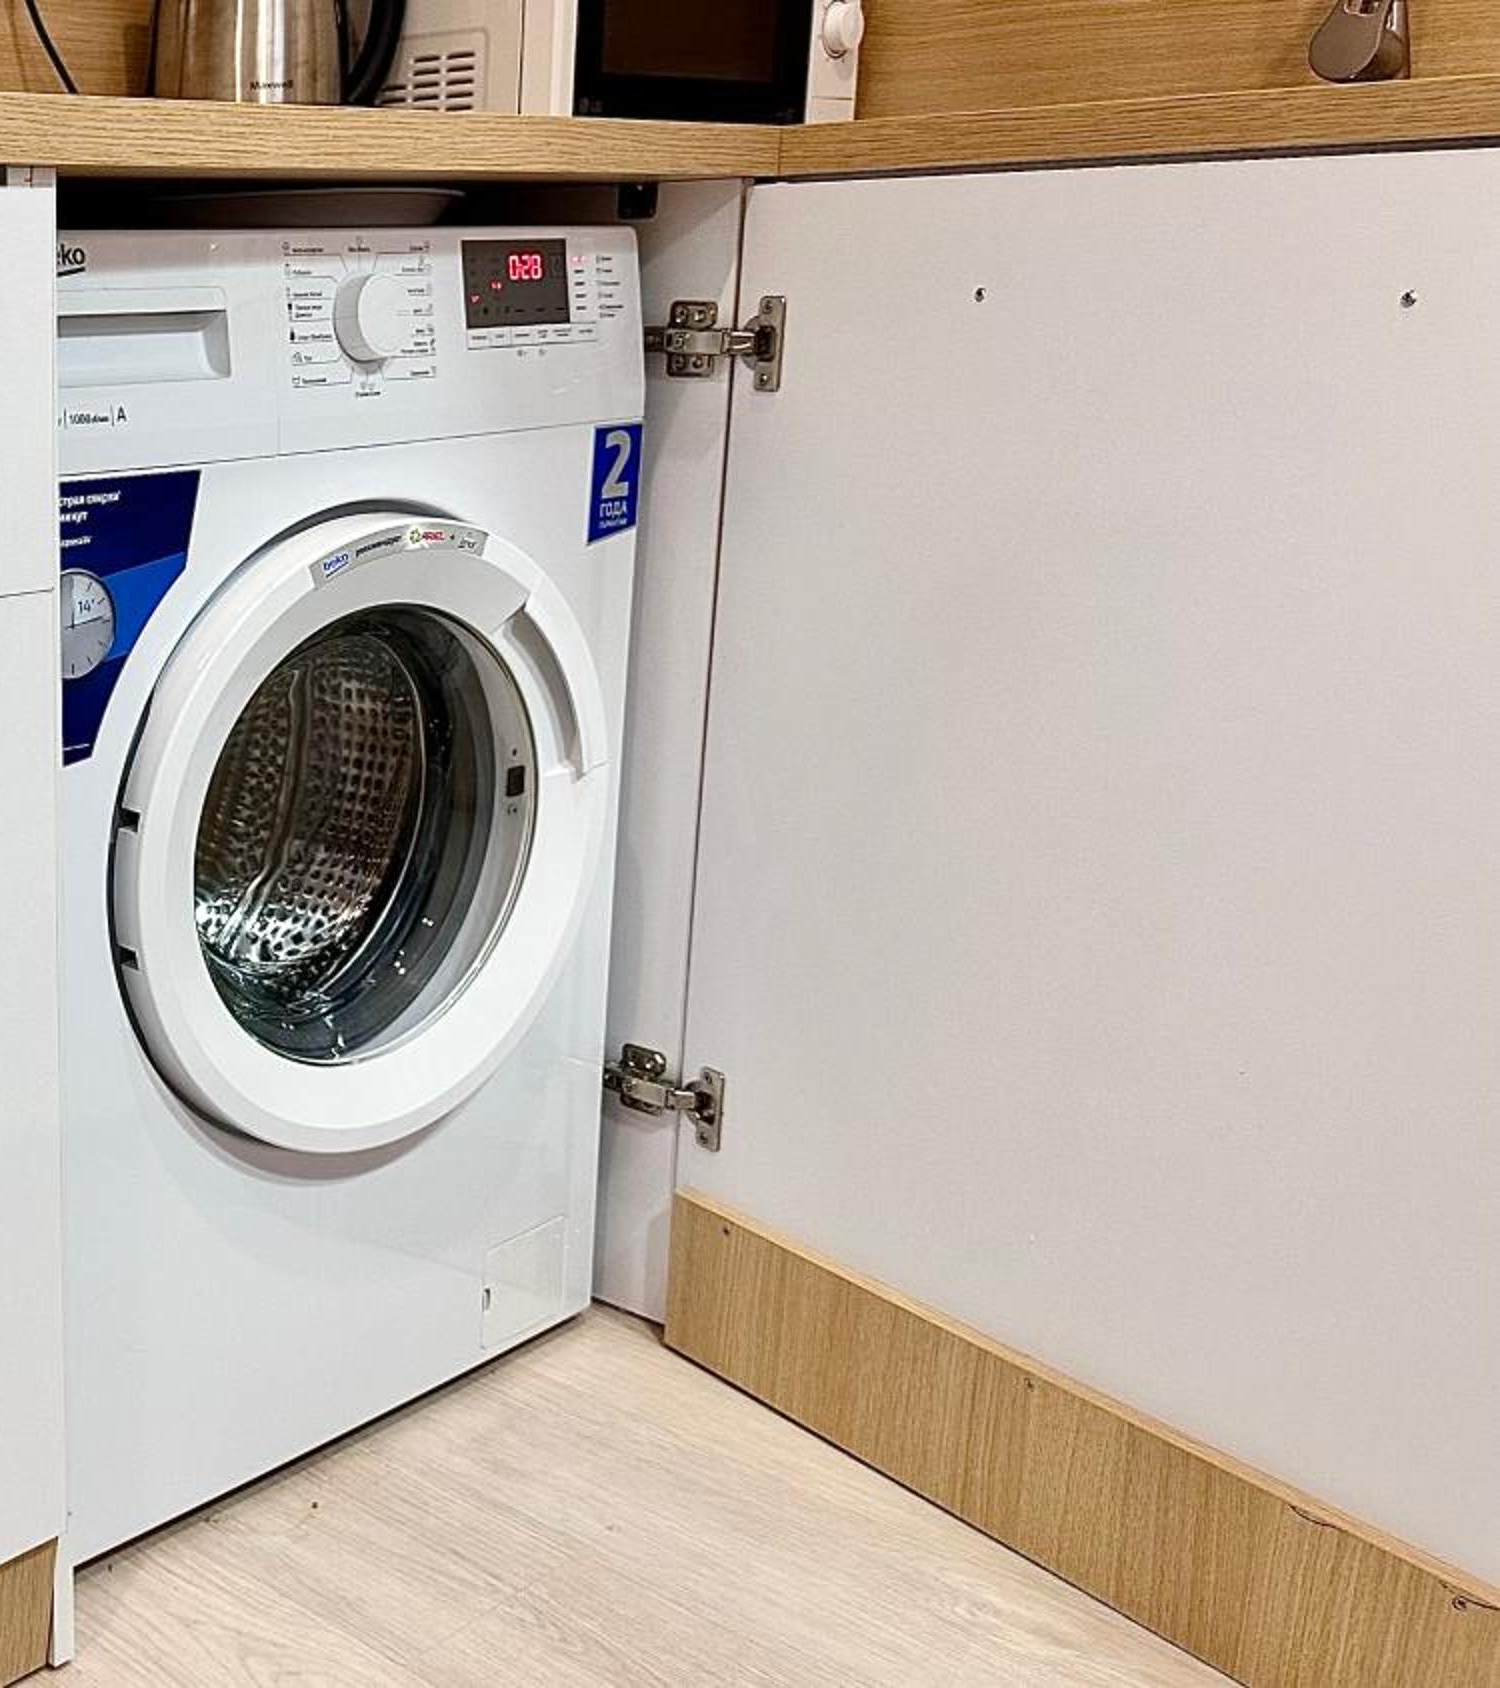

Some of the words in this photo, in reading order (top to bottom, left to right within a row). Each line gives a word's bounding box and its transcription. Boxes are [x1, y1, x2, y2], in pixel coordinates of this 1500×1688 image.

[57, 243, 86, 266] ko
[601, 429, 632, 500] 2
[599, 500, 628, 519] ГОДА
